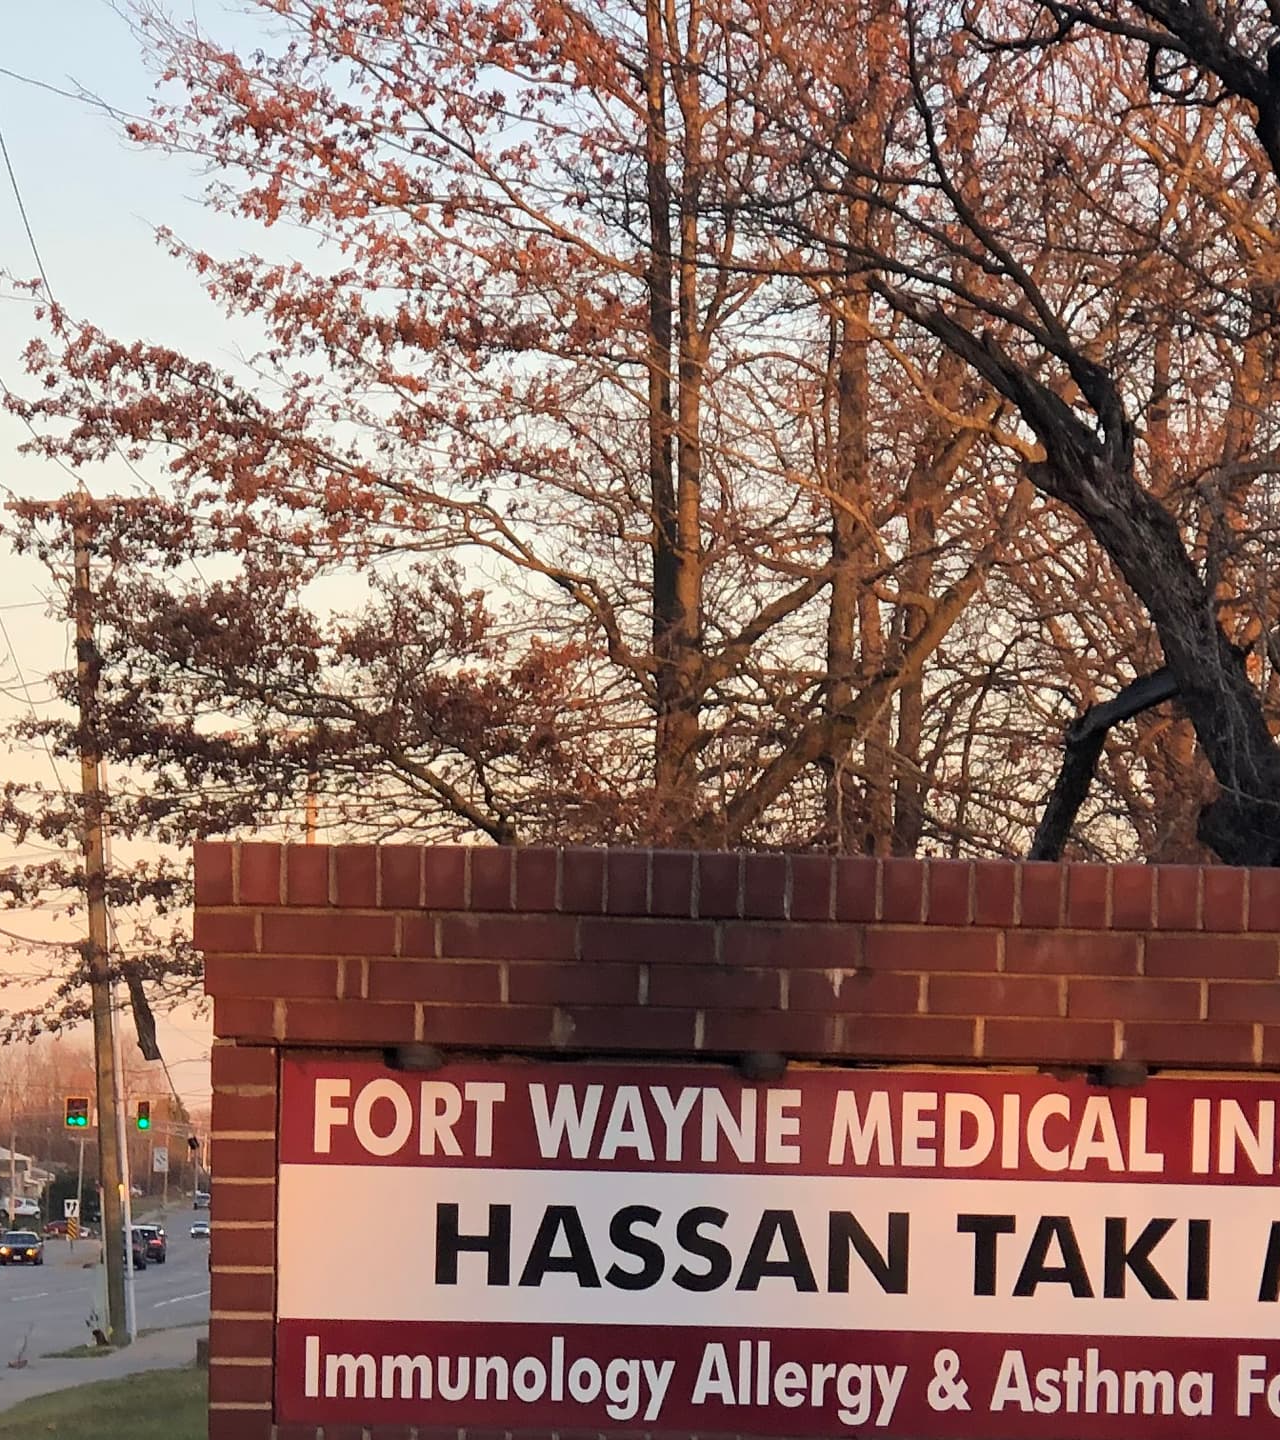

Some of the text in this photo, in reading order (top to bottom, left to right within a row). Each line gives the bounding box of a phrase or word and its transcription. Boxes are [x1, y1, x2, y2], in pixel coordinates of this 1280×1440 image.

[313, 1078, 506, 1157] FORT
[528, 1083, 802, 1164] WAYNE
[828, 1090, 1164, 1173] MEDICAL
[434, 1202, 910, 1295] HASSAN
[956, 1213, 1211, 1301] TAKI
[304, 1335, 676, 1421] Immunology
[691, 1340, 908, 1427] Allergy
[927, 1348, 972, 1412] &
[989, 1348, 1214, 1417] Asthma
